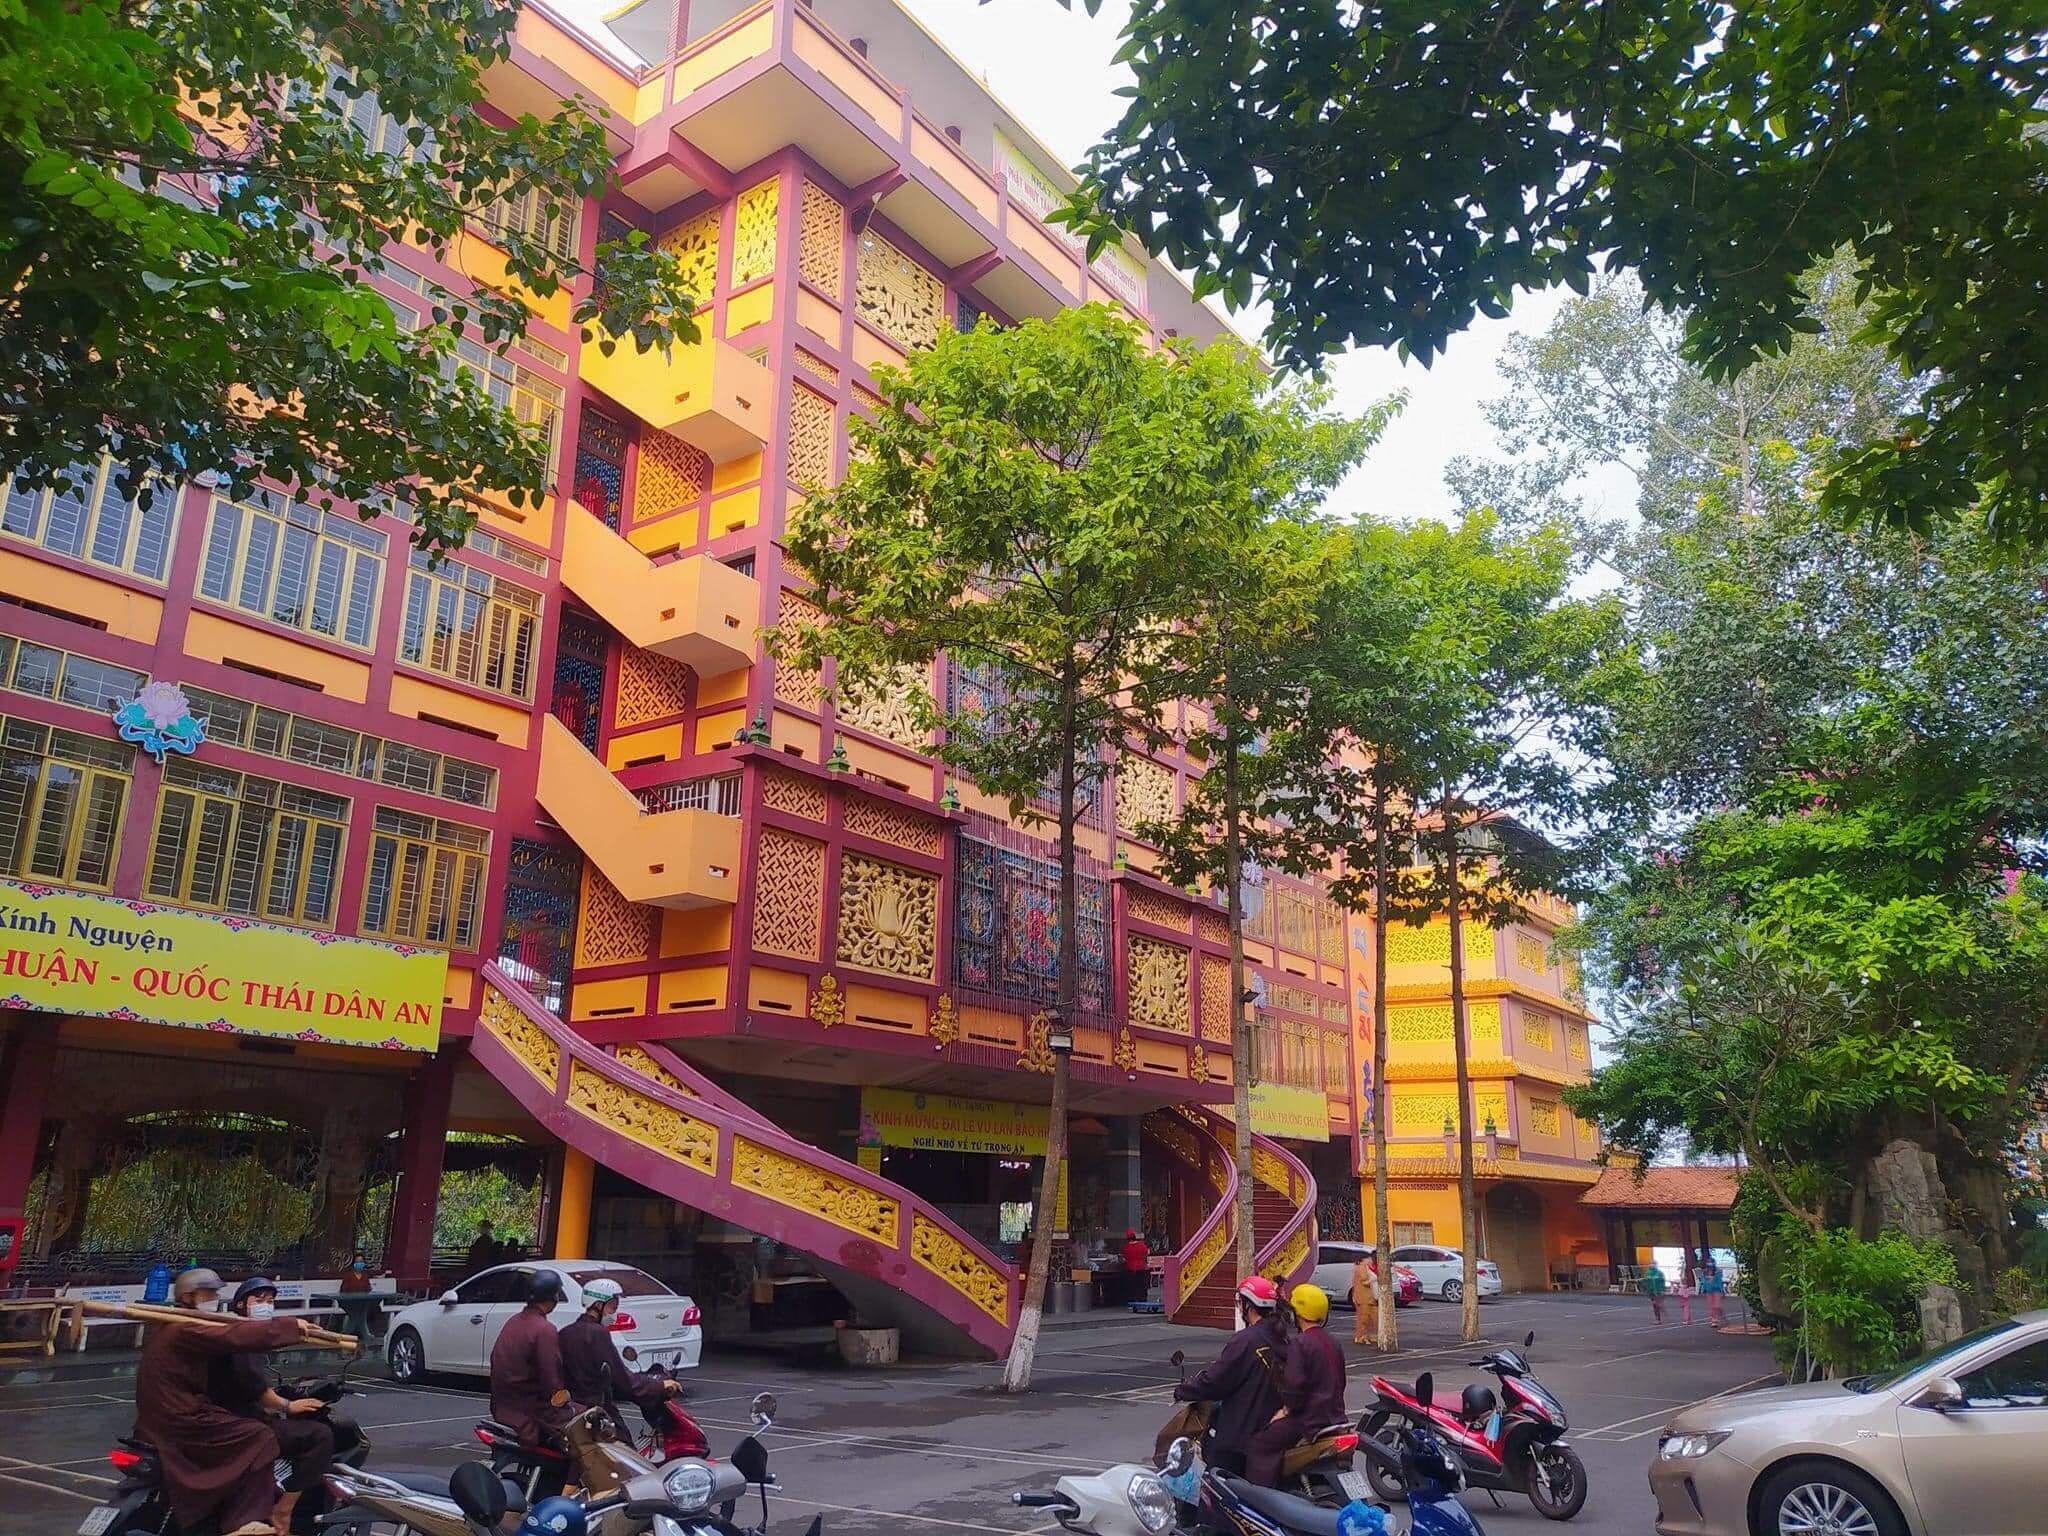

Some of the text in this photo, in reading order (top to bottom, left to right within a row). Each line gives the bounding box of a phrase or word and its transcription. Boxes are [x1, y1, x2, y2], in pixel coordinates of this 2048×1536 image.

[0, 905, 174, 954] Kính Nguyện
[132, 963, 231, 1002] QUỐC
[241, 981, 315, 1013] THÁI
[323, 989, 386, 1021] DÂN
[393, 1001, 433, 1026] AN
